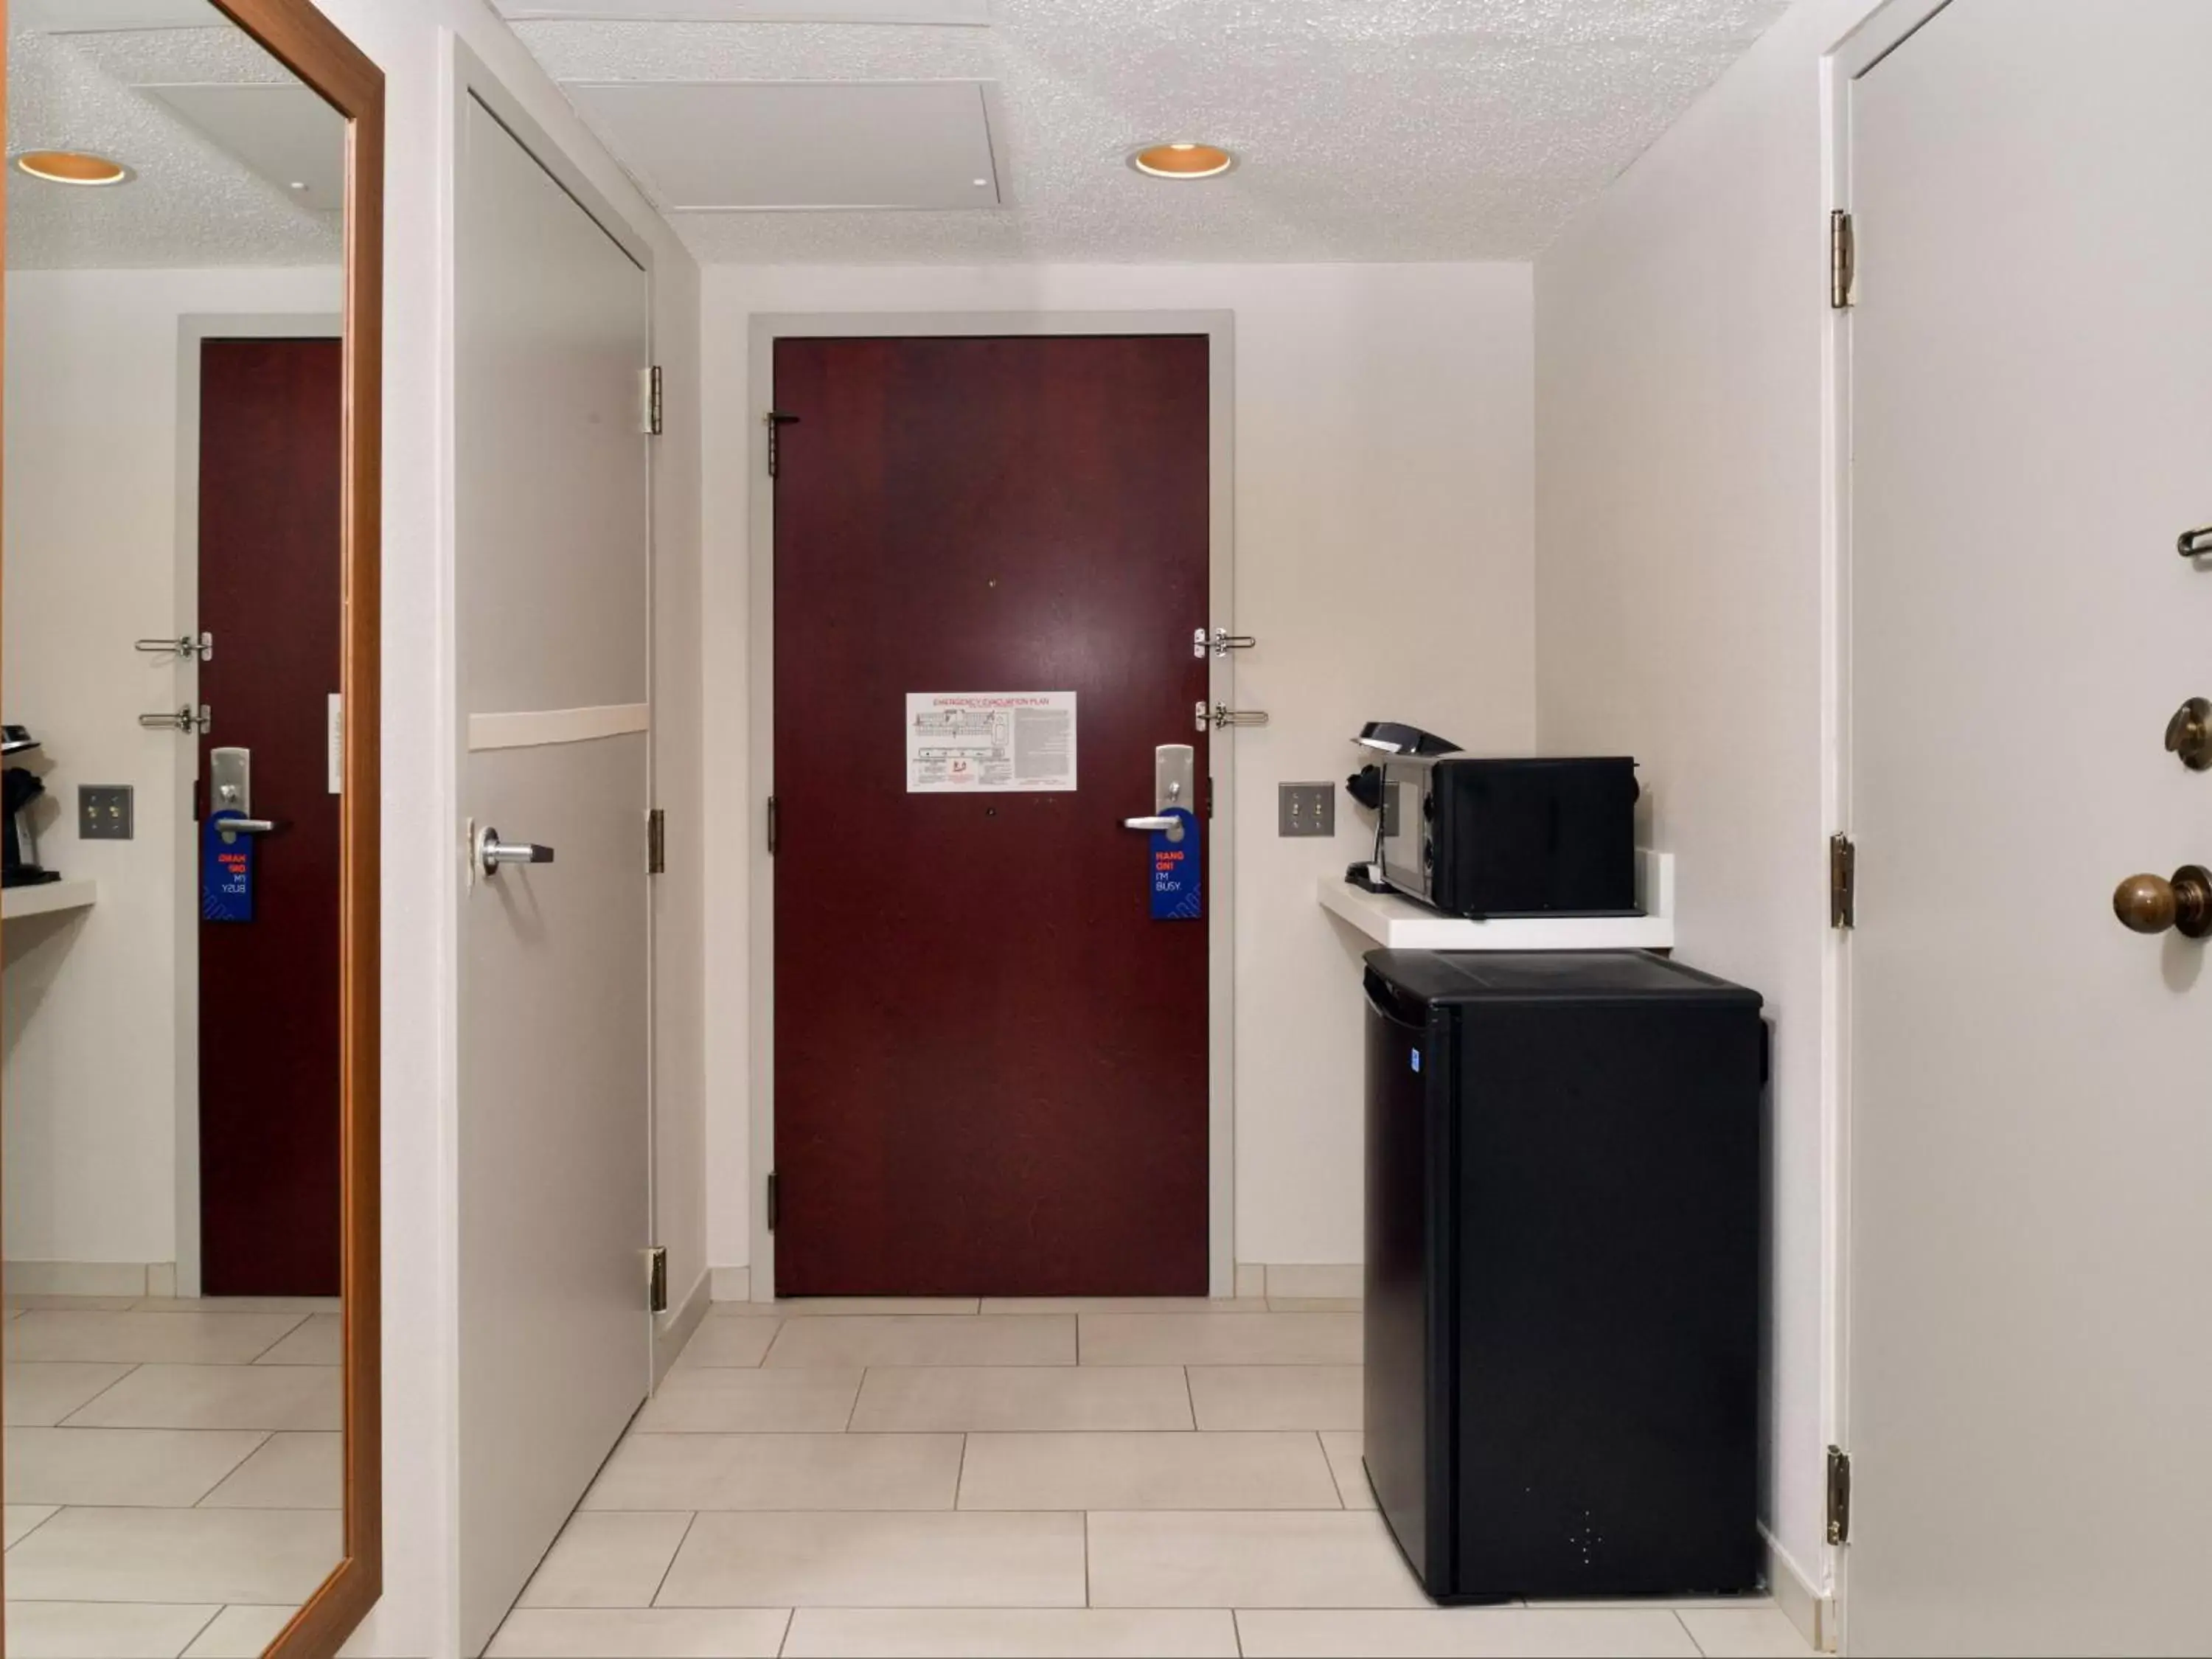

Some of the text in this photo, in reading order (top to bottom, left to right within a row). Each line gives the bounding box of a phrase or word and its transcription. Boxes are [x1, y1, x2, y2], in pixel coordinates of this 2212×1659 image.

[933, 698, 980, 706] EMERGENCY
[983, 698, 1028, 706] EVACUATION
[1156, 851, 1184, 860] HANG
[1156, 872, 1169, 880] I'M
